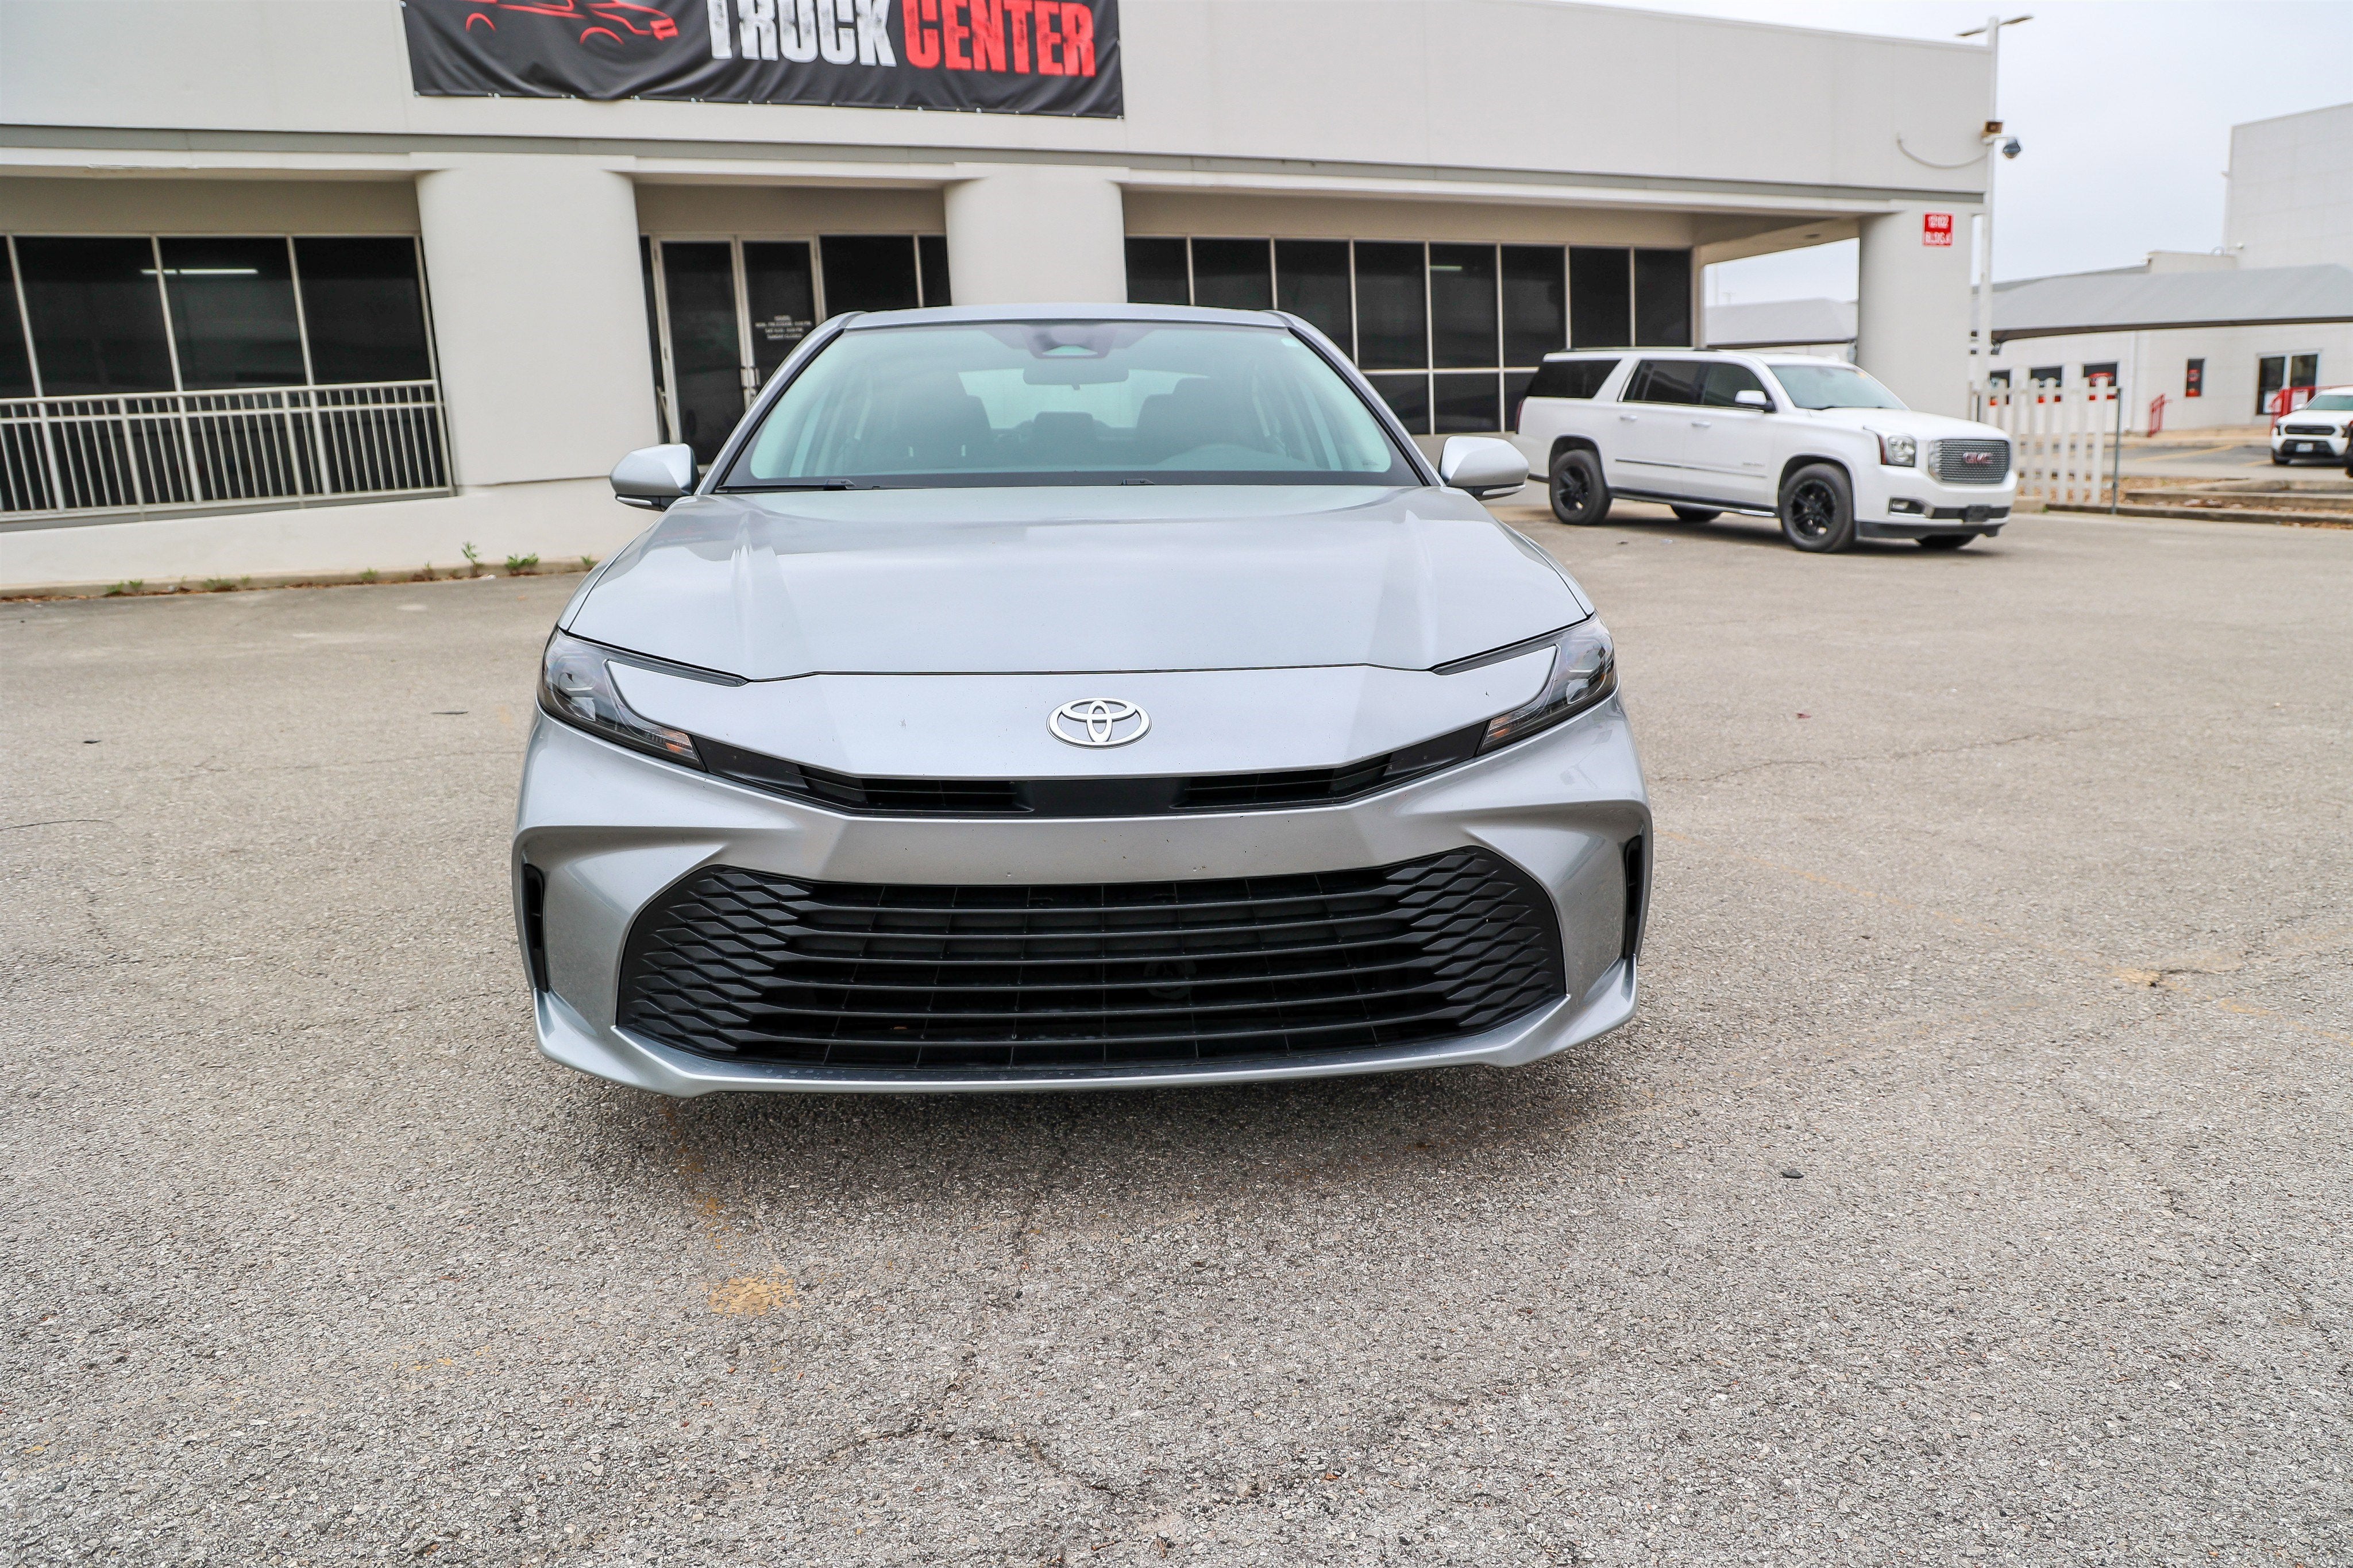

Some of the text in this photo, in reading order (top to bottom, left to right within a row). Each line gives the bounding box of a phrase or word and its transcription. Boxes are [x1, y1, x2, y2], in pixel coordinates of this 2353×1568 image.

[707, 0, 1097, 78] TRUCK CENTER
[1962, 451, 1994, 464] GMC
